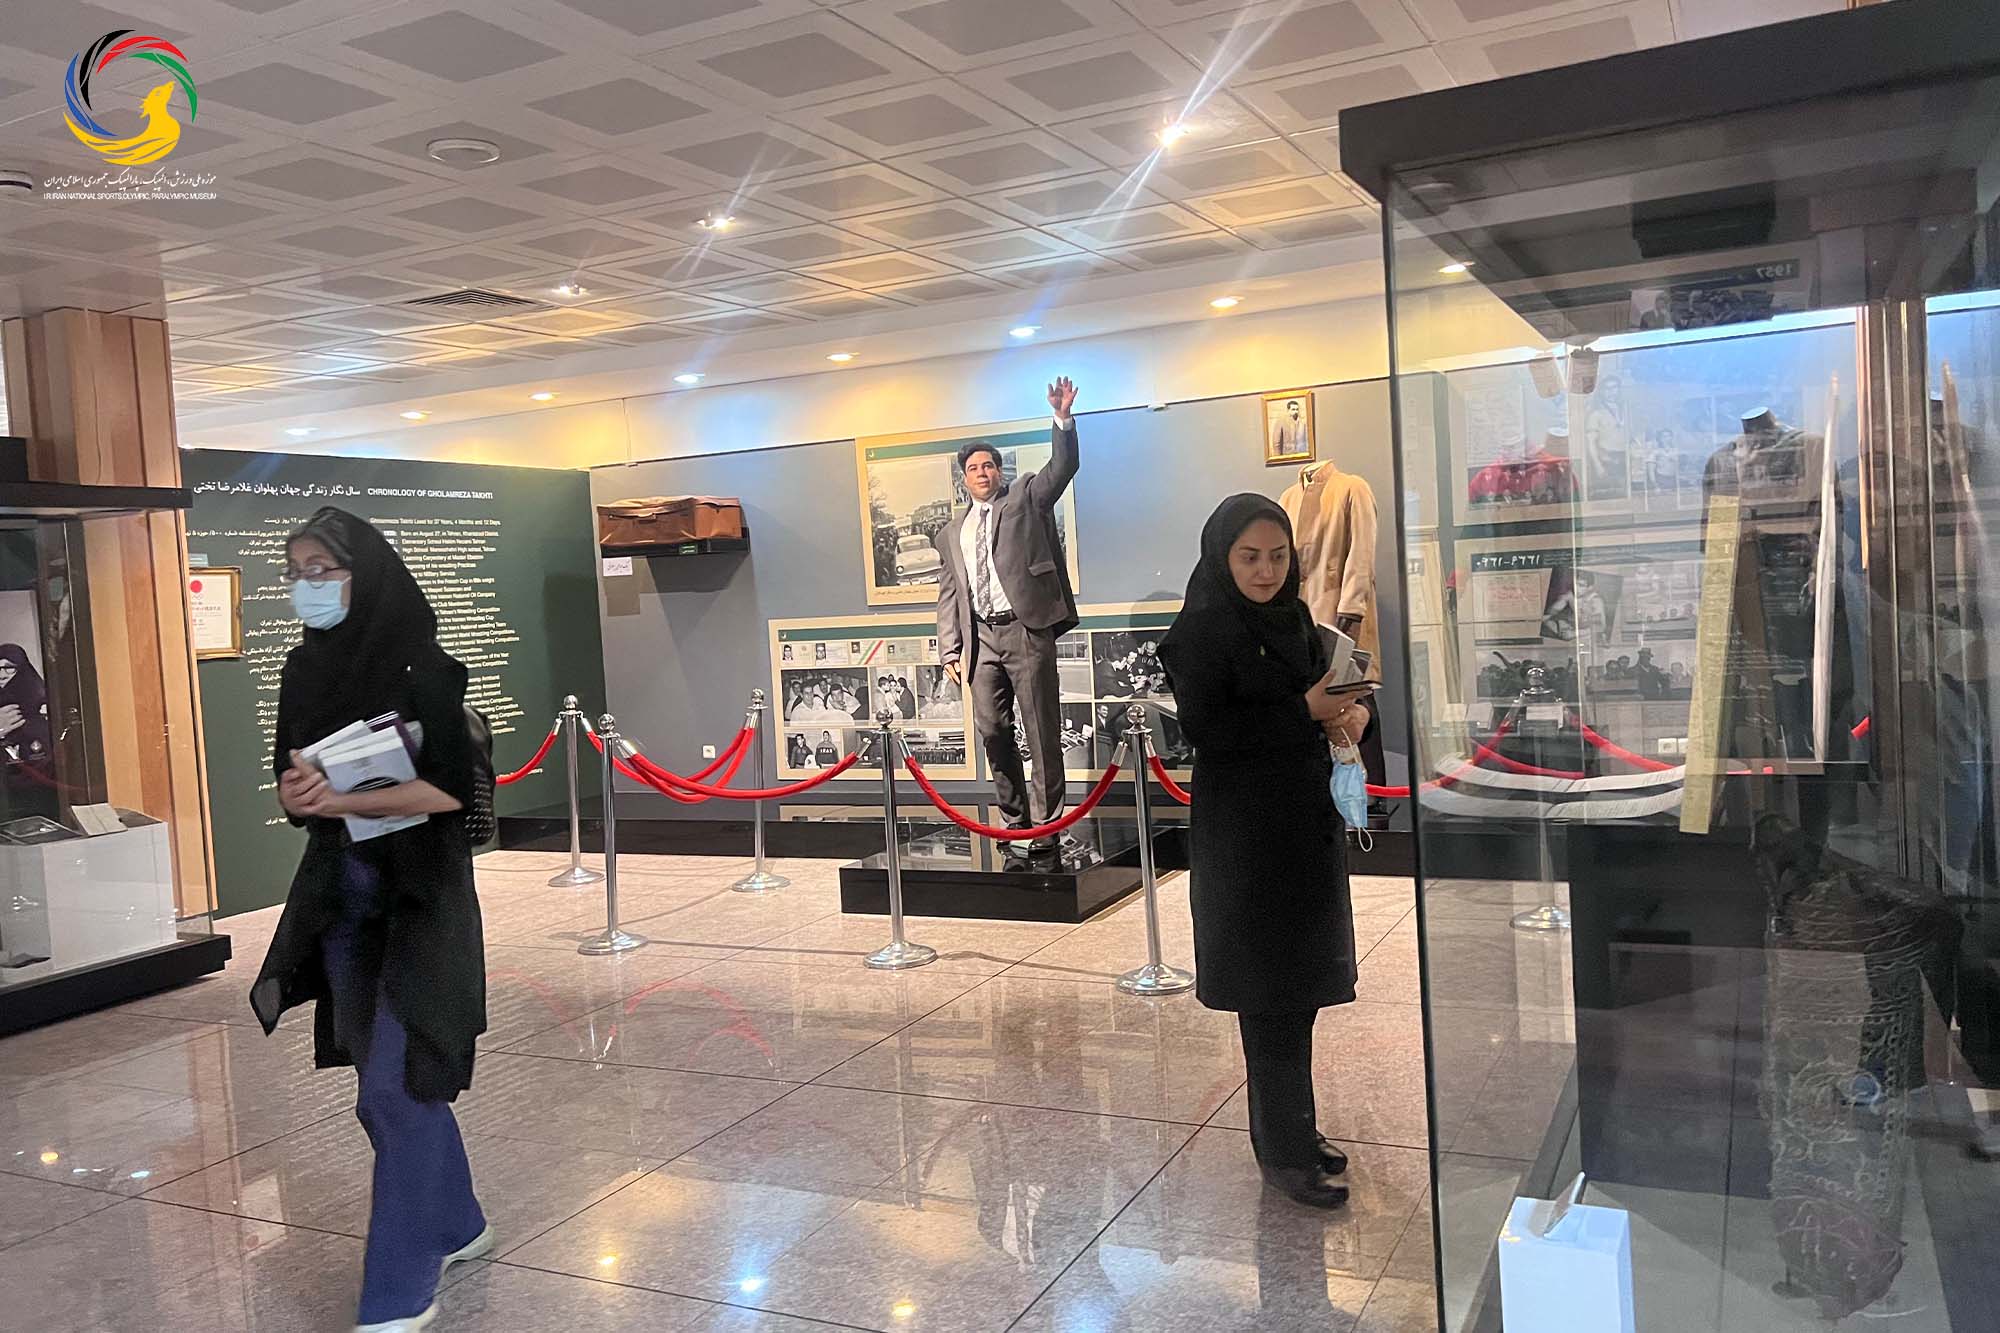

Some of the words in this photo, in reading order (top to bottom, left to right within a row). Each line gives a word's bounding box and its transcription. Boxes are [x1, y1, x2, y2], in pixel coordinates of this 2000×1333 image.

[193, 480, 216, 494] تختی
[217, 480, 252, 495] غلامرضا
[253, 482, 279, 497] پهلوان
[279, 483, 301, 497] جهان
[367, 487, 416, 497] CHRONOLOGY
[417, 489, 427, 497] OF
[427, 489, 472, 499] GHOLAMREZA
